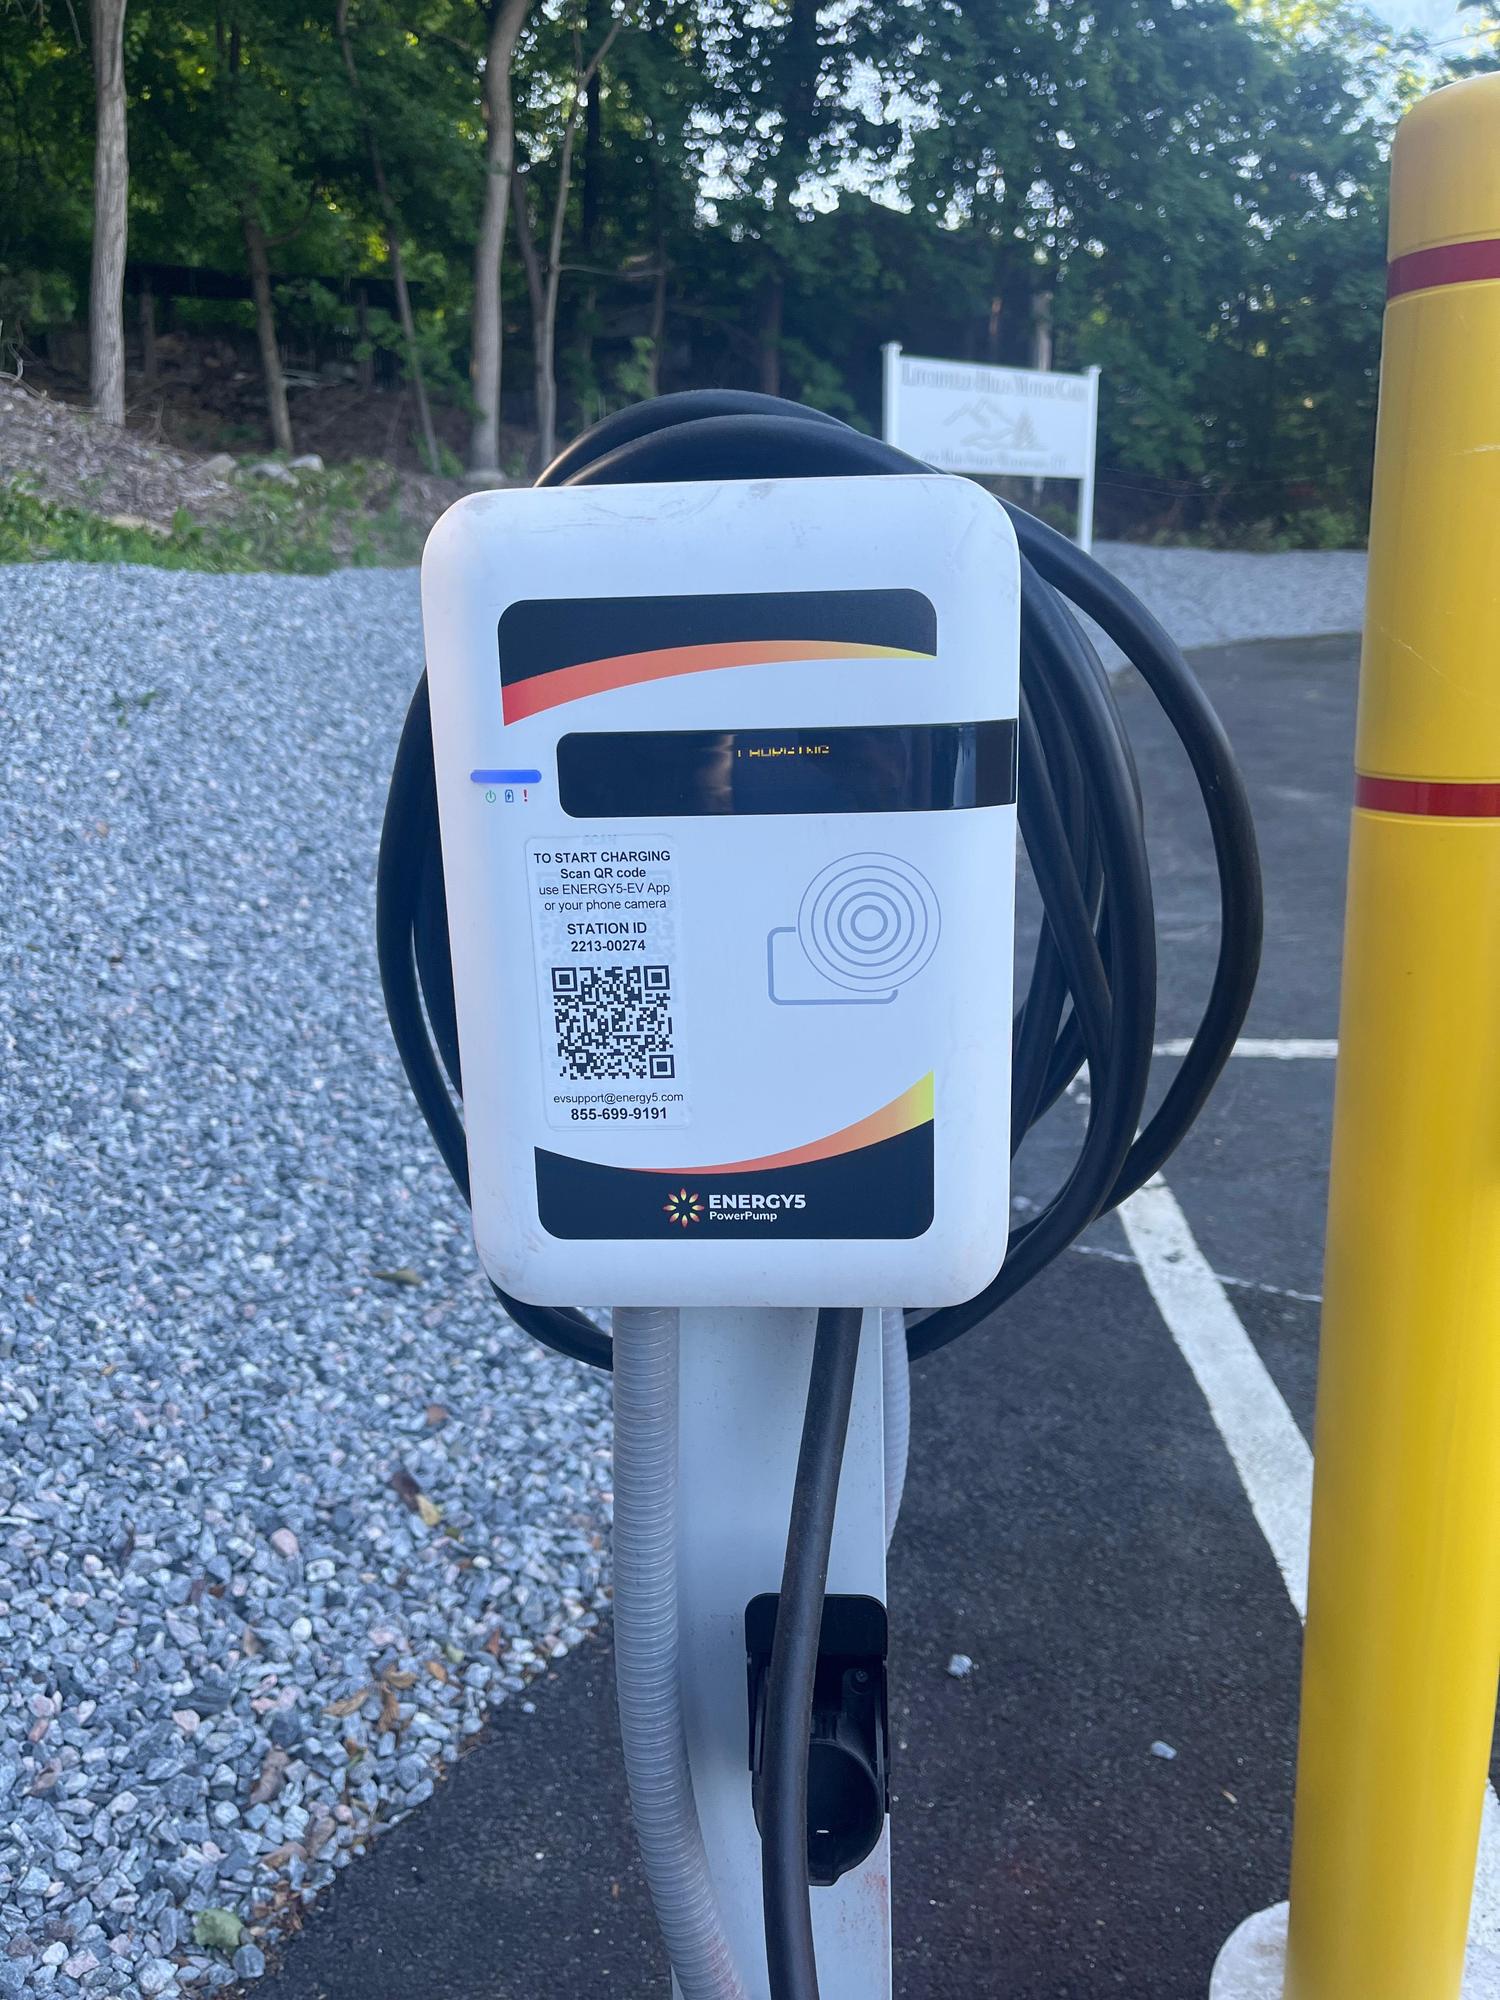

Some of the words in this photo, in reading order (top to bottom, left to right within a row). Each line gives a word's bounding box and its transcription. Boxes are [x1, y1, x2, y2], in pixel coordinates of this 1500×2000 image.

[534, 853, 552, 864] TO
[555, 852, 598, 864] START
[601, 851, 671, 863] CHARGING
[561, 869, 591, 879] Scan
[594, 868, 614, 879] QR
[617, 868, 647, 878] code
[539, 886, 559, 896] use
[563, 883, 645, 895] ENERGY5-EV
[648, 883, 671, 896] App
[545, 902, 556, 911] or
[559, 901, 584, 913] your
[587, 900, 622, 912] phone
[625, 900, 667, 910] camera
[568, 923, 629, 935] STATION
[634, 922, 647, 934] ID
[571, 940, 647, 952] 2213-00274
[554, 1093, 684, 1105] evsupport@energy5.com
[571, 1107, 667, 1121] 855-699-9191
[709, 1195, 807, 1210] ENERGY5
[710, 1212, 778, 1223] PowerPump
